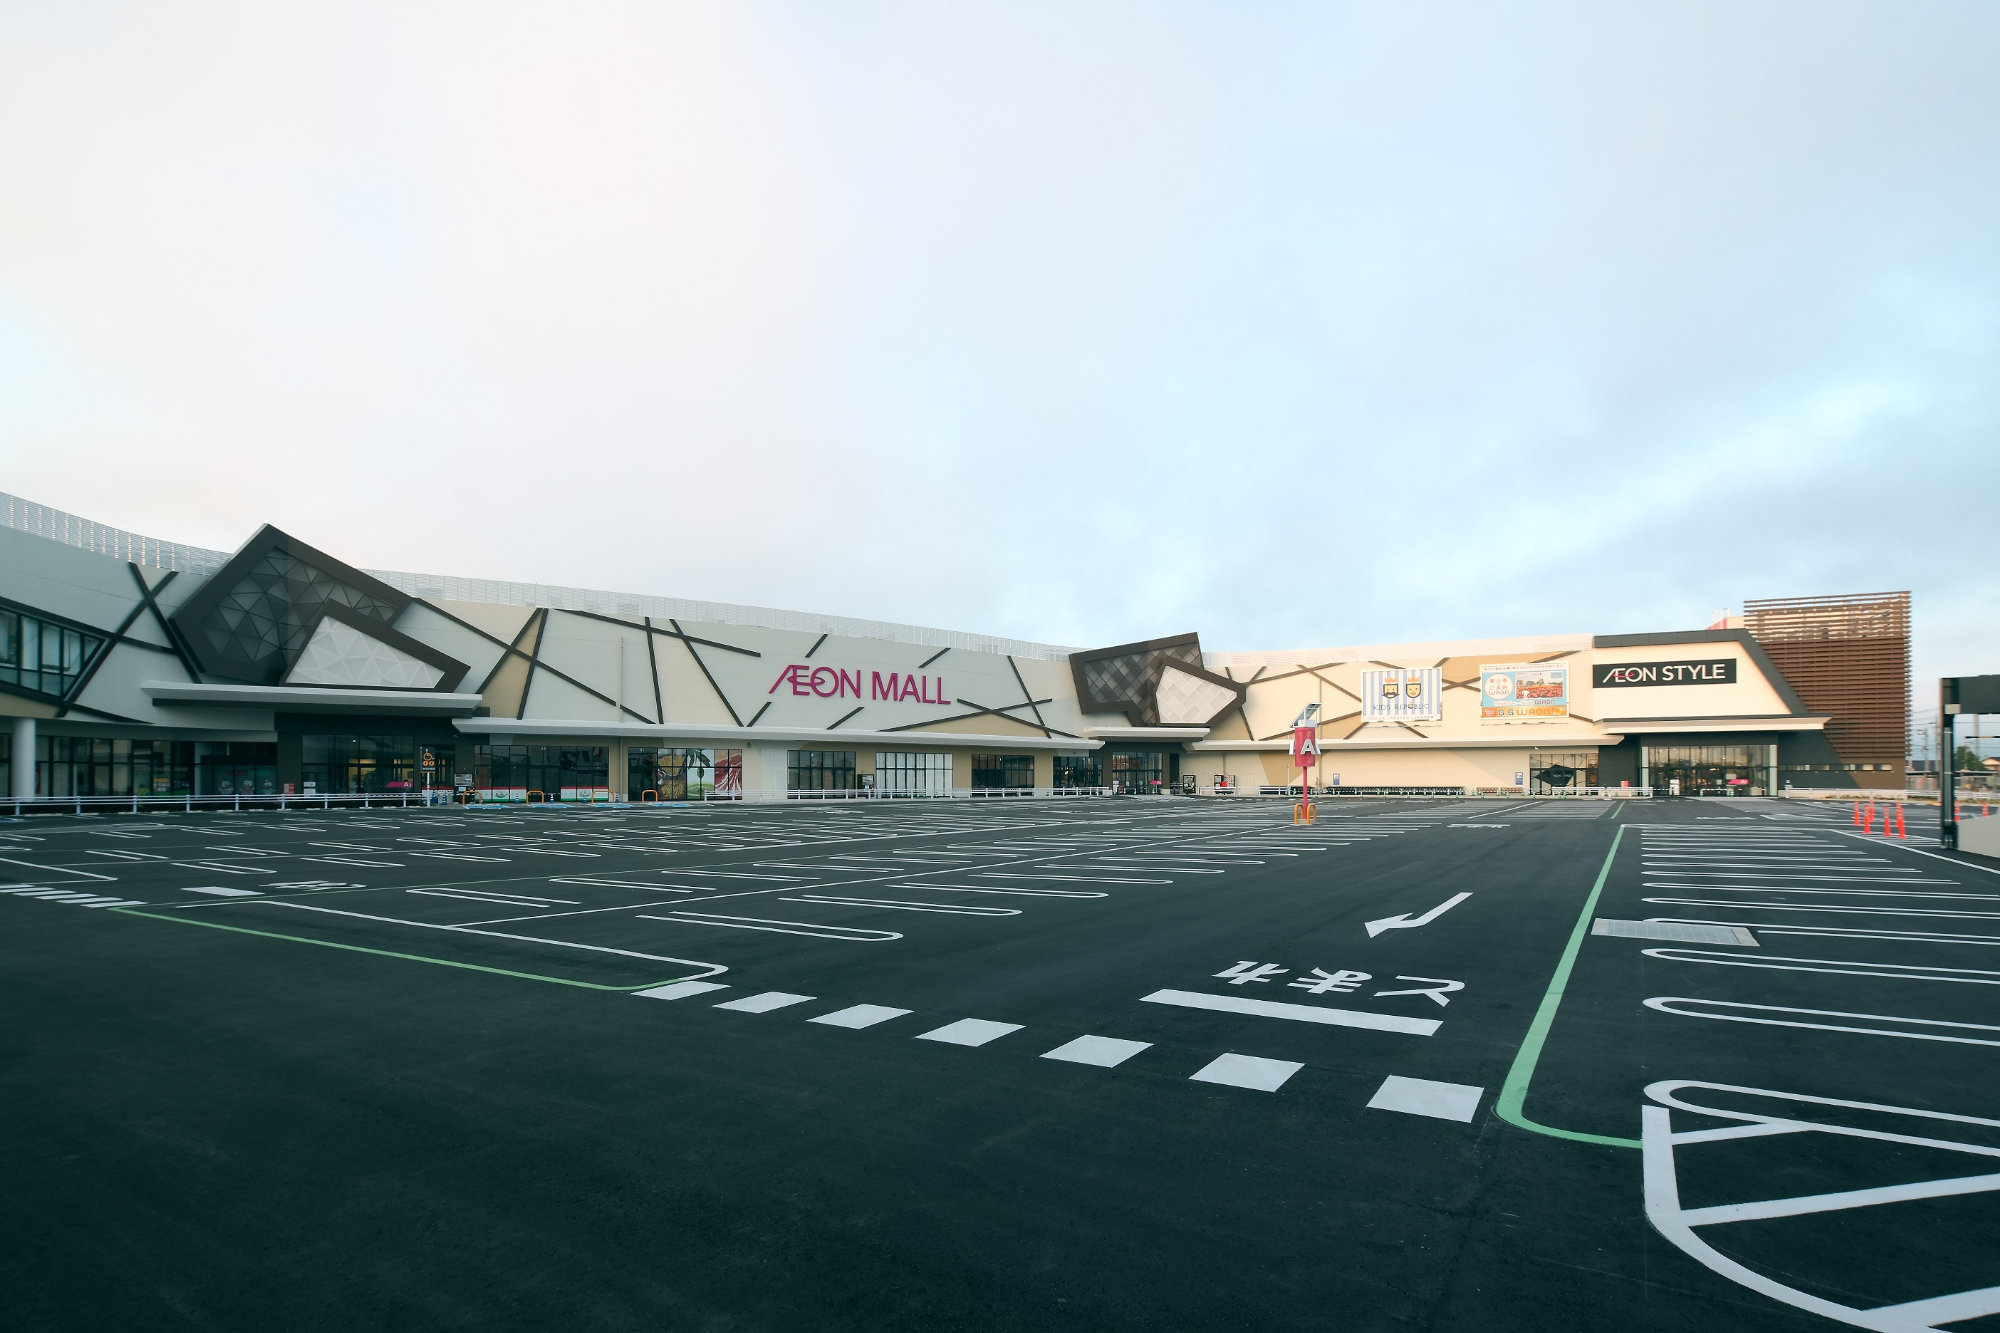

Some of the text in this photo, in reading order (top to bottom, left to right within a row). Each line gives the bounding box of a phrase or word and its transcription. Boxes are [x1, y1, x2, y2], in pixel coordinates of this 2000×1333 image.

[1662, 664, 1726, 682] STYLE
[872, 670, 952, 705] MALL
[1517, 708, 1551, 716] WAON
[1300, 738, 1316, 755] A
[1210, 960, 1466, 1008] とまれ
